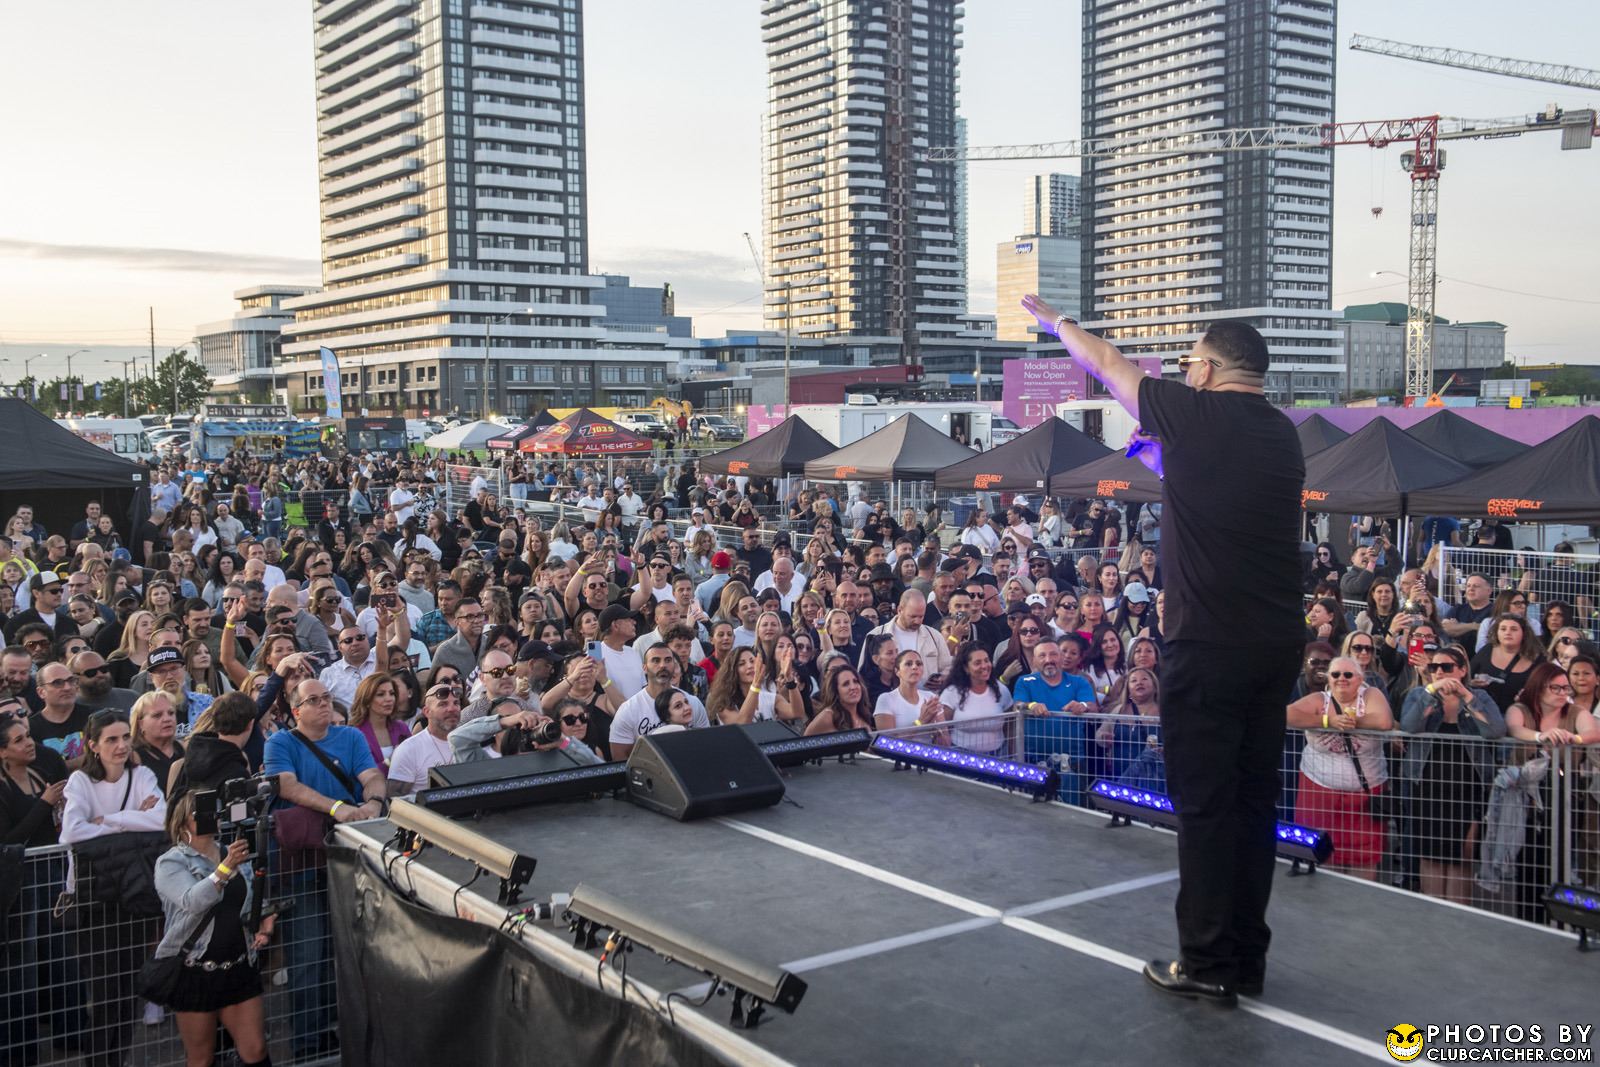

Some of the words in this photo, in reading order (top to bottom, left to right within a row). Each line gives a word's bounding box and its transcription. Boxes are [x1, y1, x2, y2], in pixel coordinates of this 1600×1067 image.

[1024, 362, 1049, 370] Model
[1050, 362, 1072, 370] Suite
[1024, 371, 1041, 379] Now
[1043, 371, 1065, 380] Open
[976, 474, 1003, 483] ASSEMBLY
[1098, 480, 1131, 490] ASSEMBLY
[1487, 498, 1544, 509] ASSEMBLY
[1487, 506, 1518, 517] PARK
[150, 651, 177, 664] Compton
